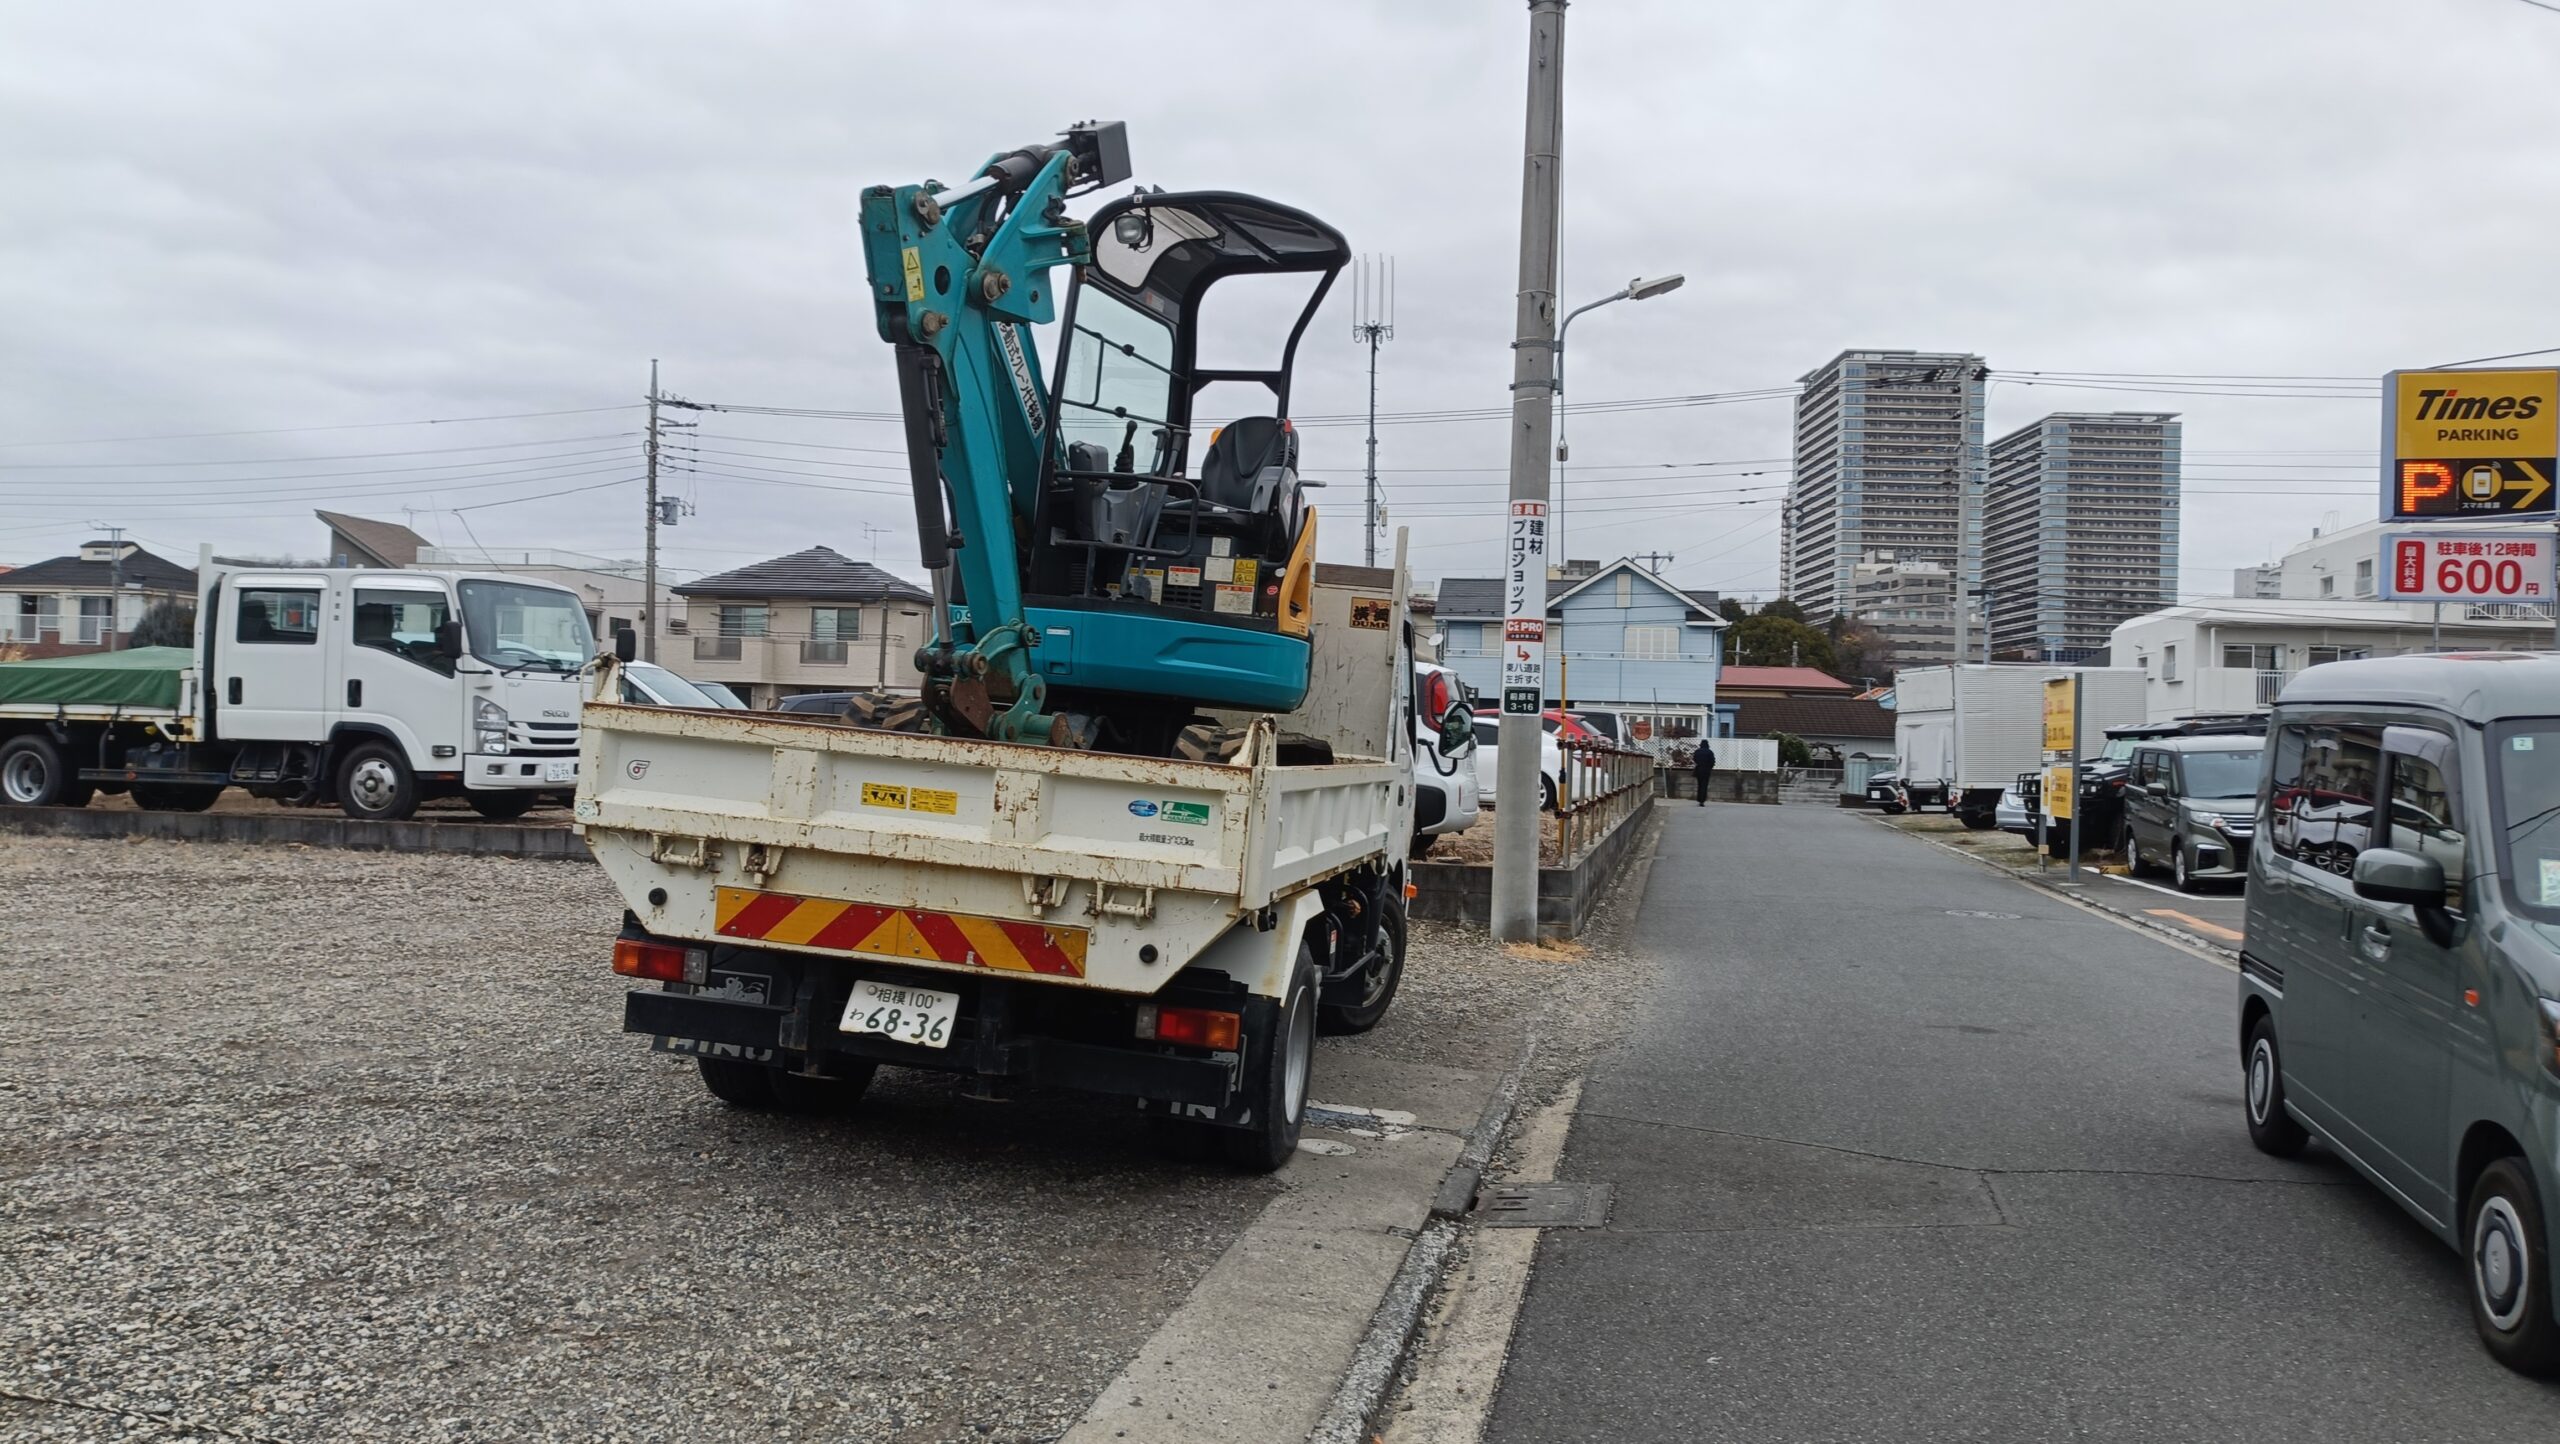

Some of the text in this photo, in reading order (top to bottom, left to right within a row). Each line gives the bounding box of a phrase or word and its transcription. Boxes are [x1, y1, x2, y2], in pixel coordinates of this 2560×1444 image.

[2416, 389, 2543, 421] Times
[2437, 428, 2520, 441] PARKING
[2402, 462, 2452, 513] P
[1529, 519, 1544, 555] 建材
[2437, 541, 2537, 557] 駐車後12時間
[1510, 518, 1527, 615] プロジョップ
[2403, 545, 2417, 589] 最大料金
[1352, 620, 1390, 628] DUMP
[1520, 621, 1543, 633] PRO
[1510, 702, 1534, 711] 3-16
[865, 1006, 948, 1042] 68-36
